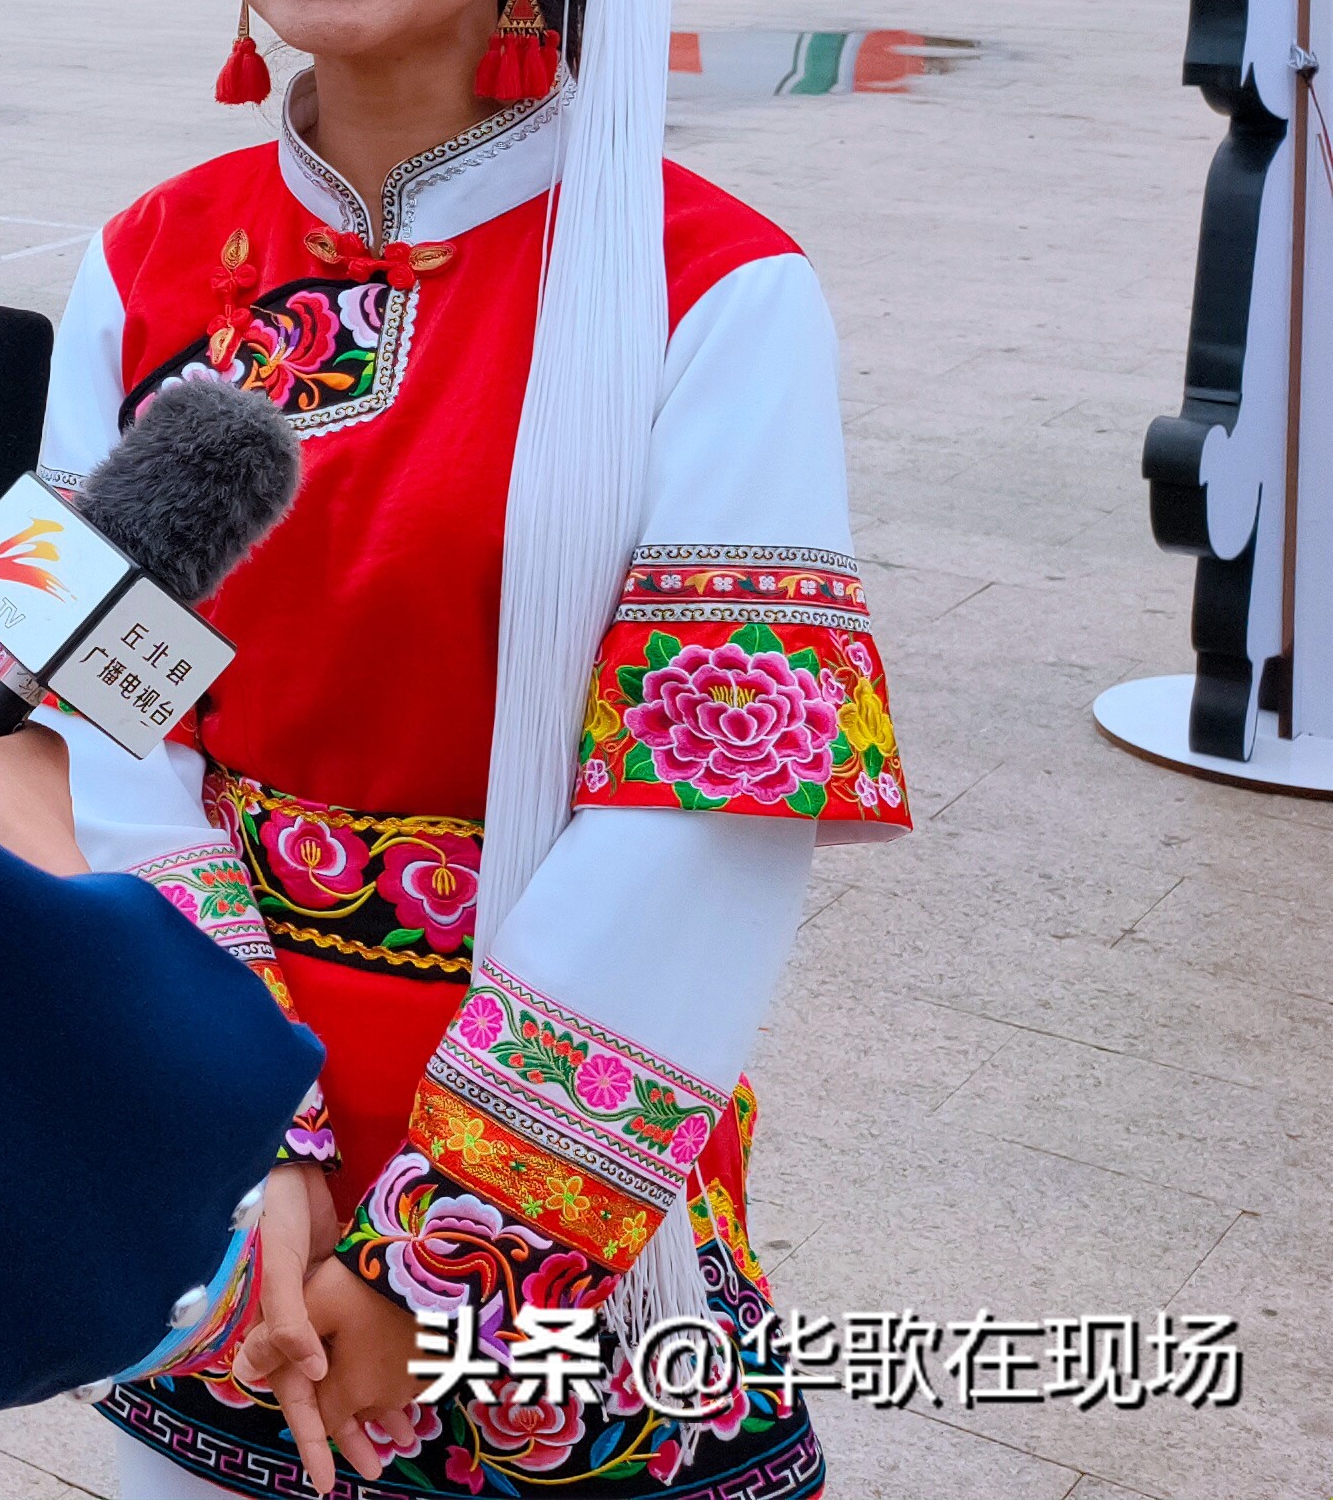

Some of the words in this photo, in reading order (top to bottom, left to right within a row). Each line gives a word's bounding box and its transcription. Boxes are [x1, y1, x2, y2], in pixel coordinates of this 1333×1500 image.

[79, 646, 175, 726] 广播电视台
[120, 623, 193, 686] 丘北县
